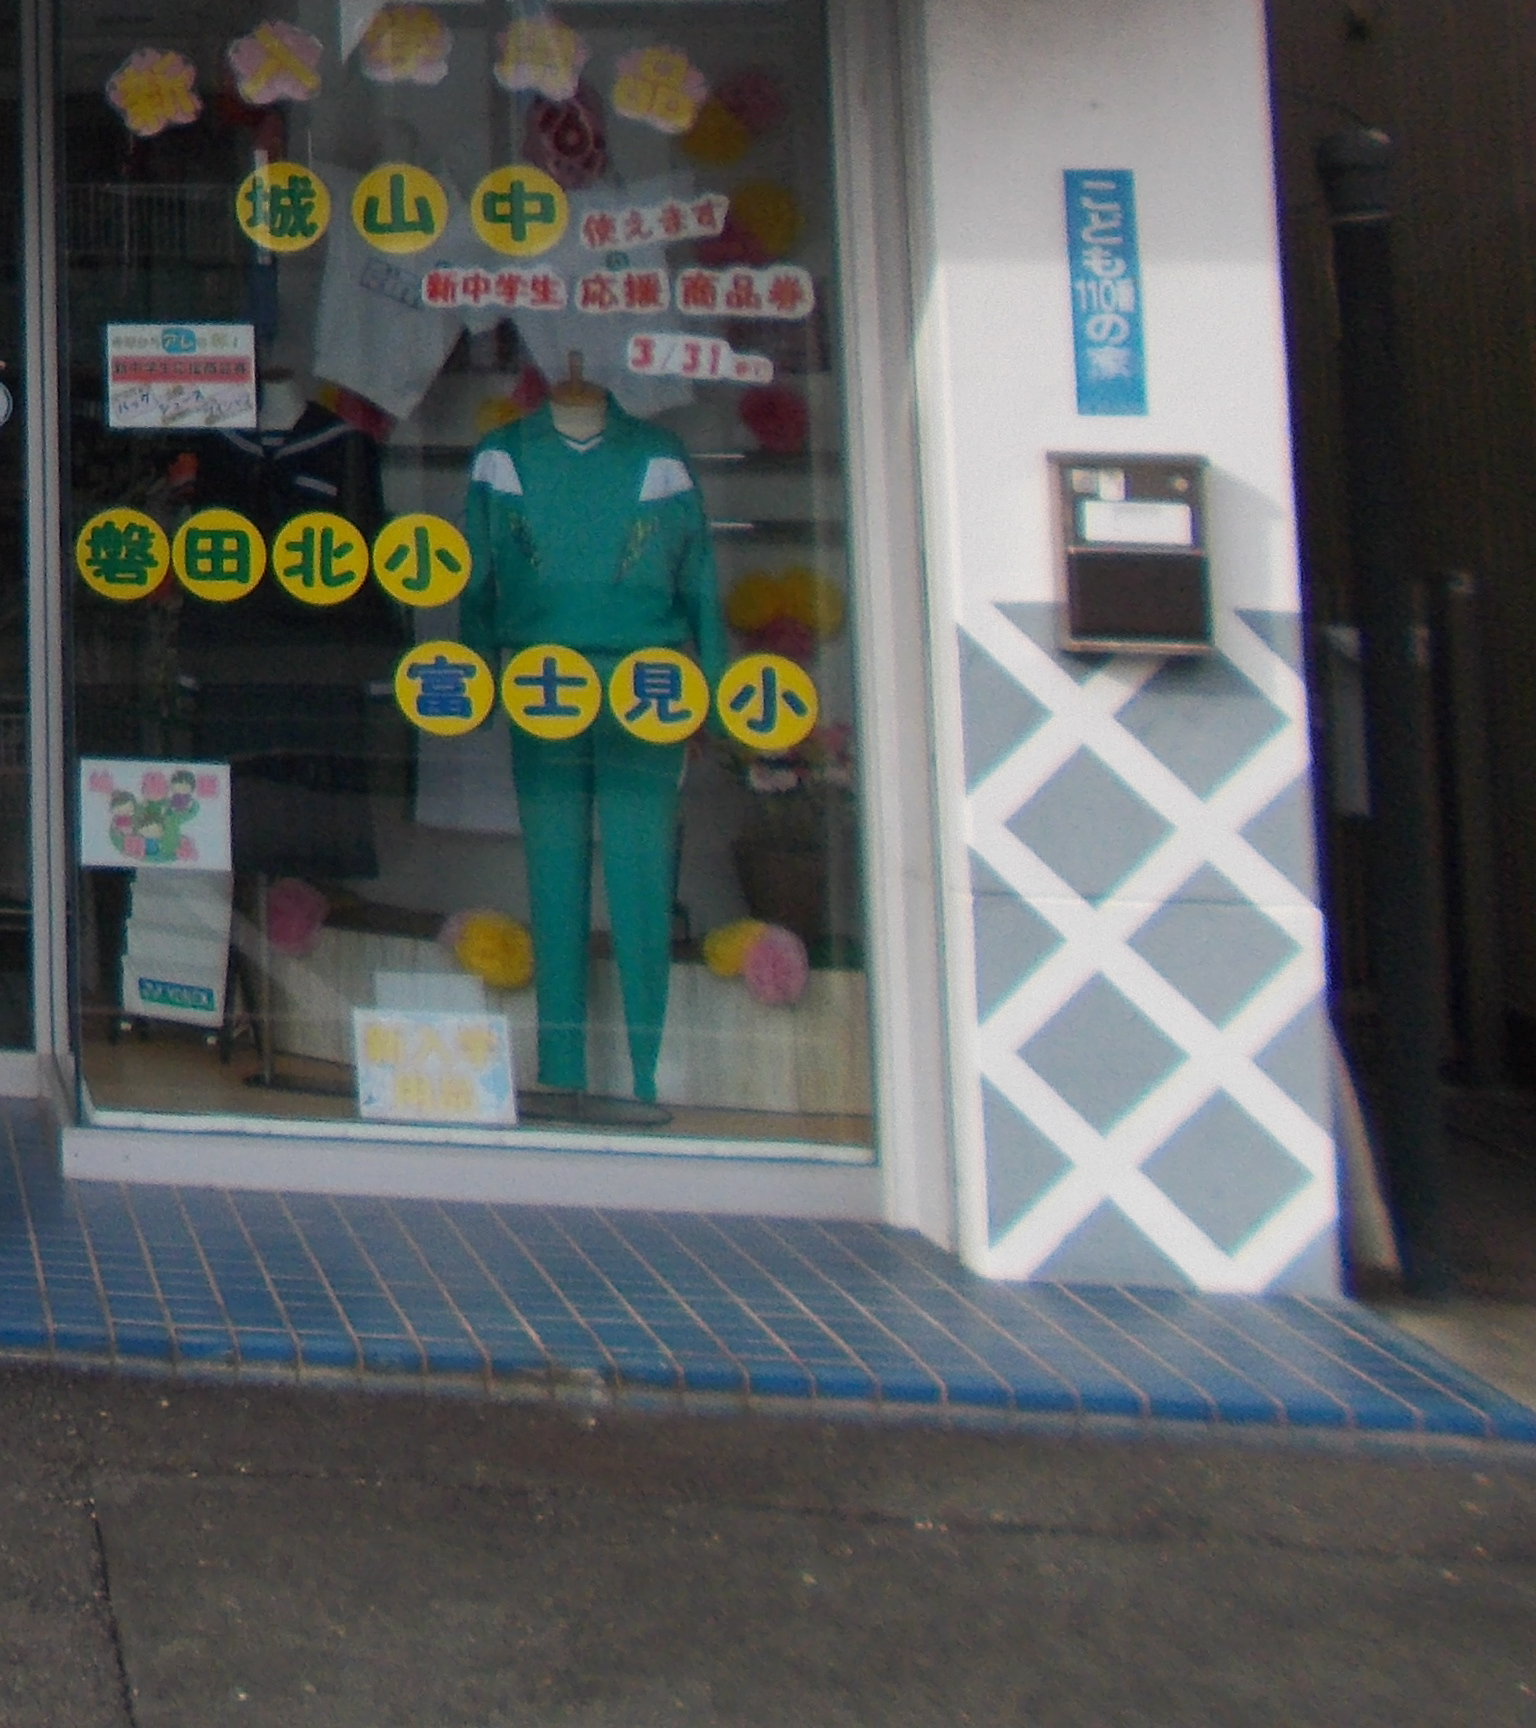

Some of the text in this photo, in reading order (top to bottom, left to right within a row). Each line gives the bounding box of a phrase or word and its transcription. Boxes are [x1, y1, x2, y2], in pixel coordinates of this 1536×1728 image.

[246, 174, 556, 243] 城山中
[583, 200, 720, 248] 使えます
[86, 524, 463, 593] 磐田北小
[406, 656, 810, 734] 富士見小
